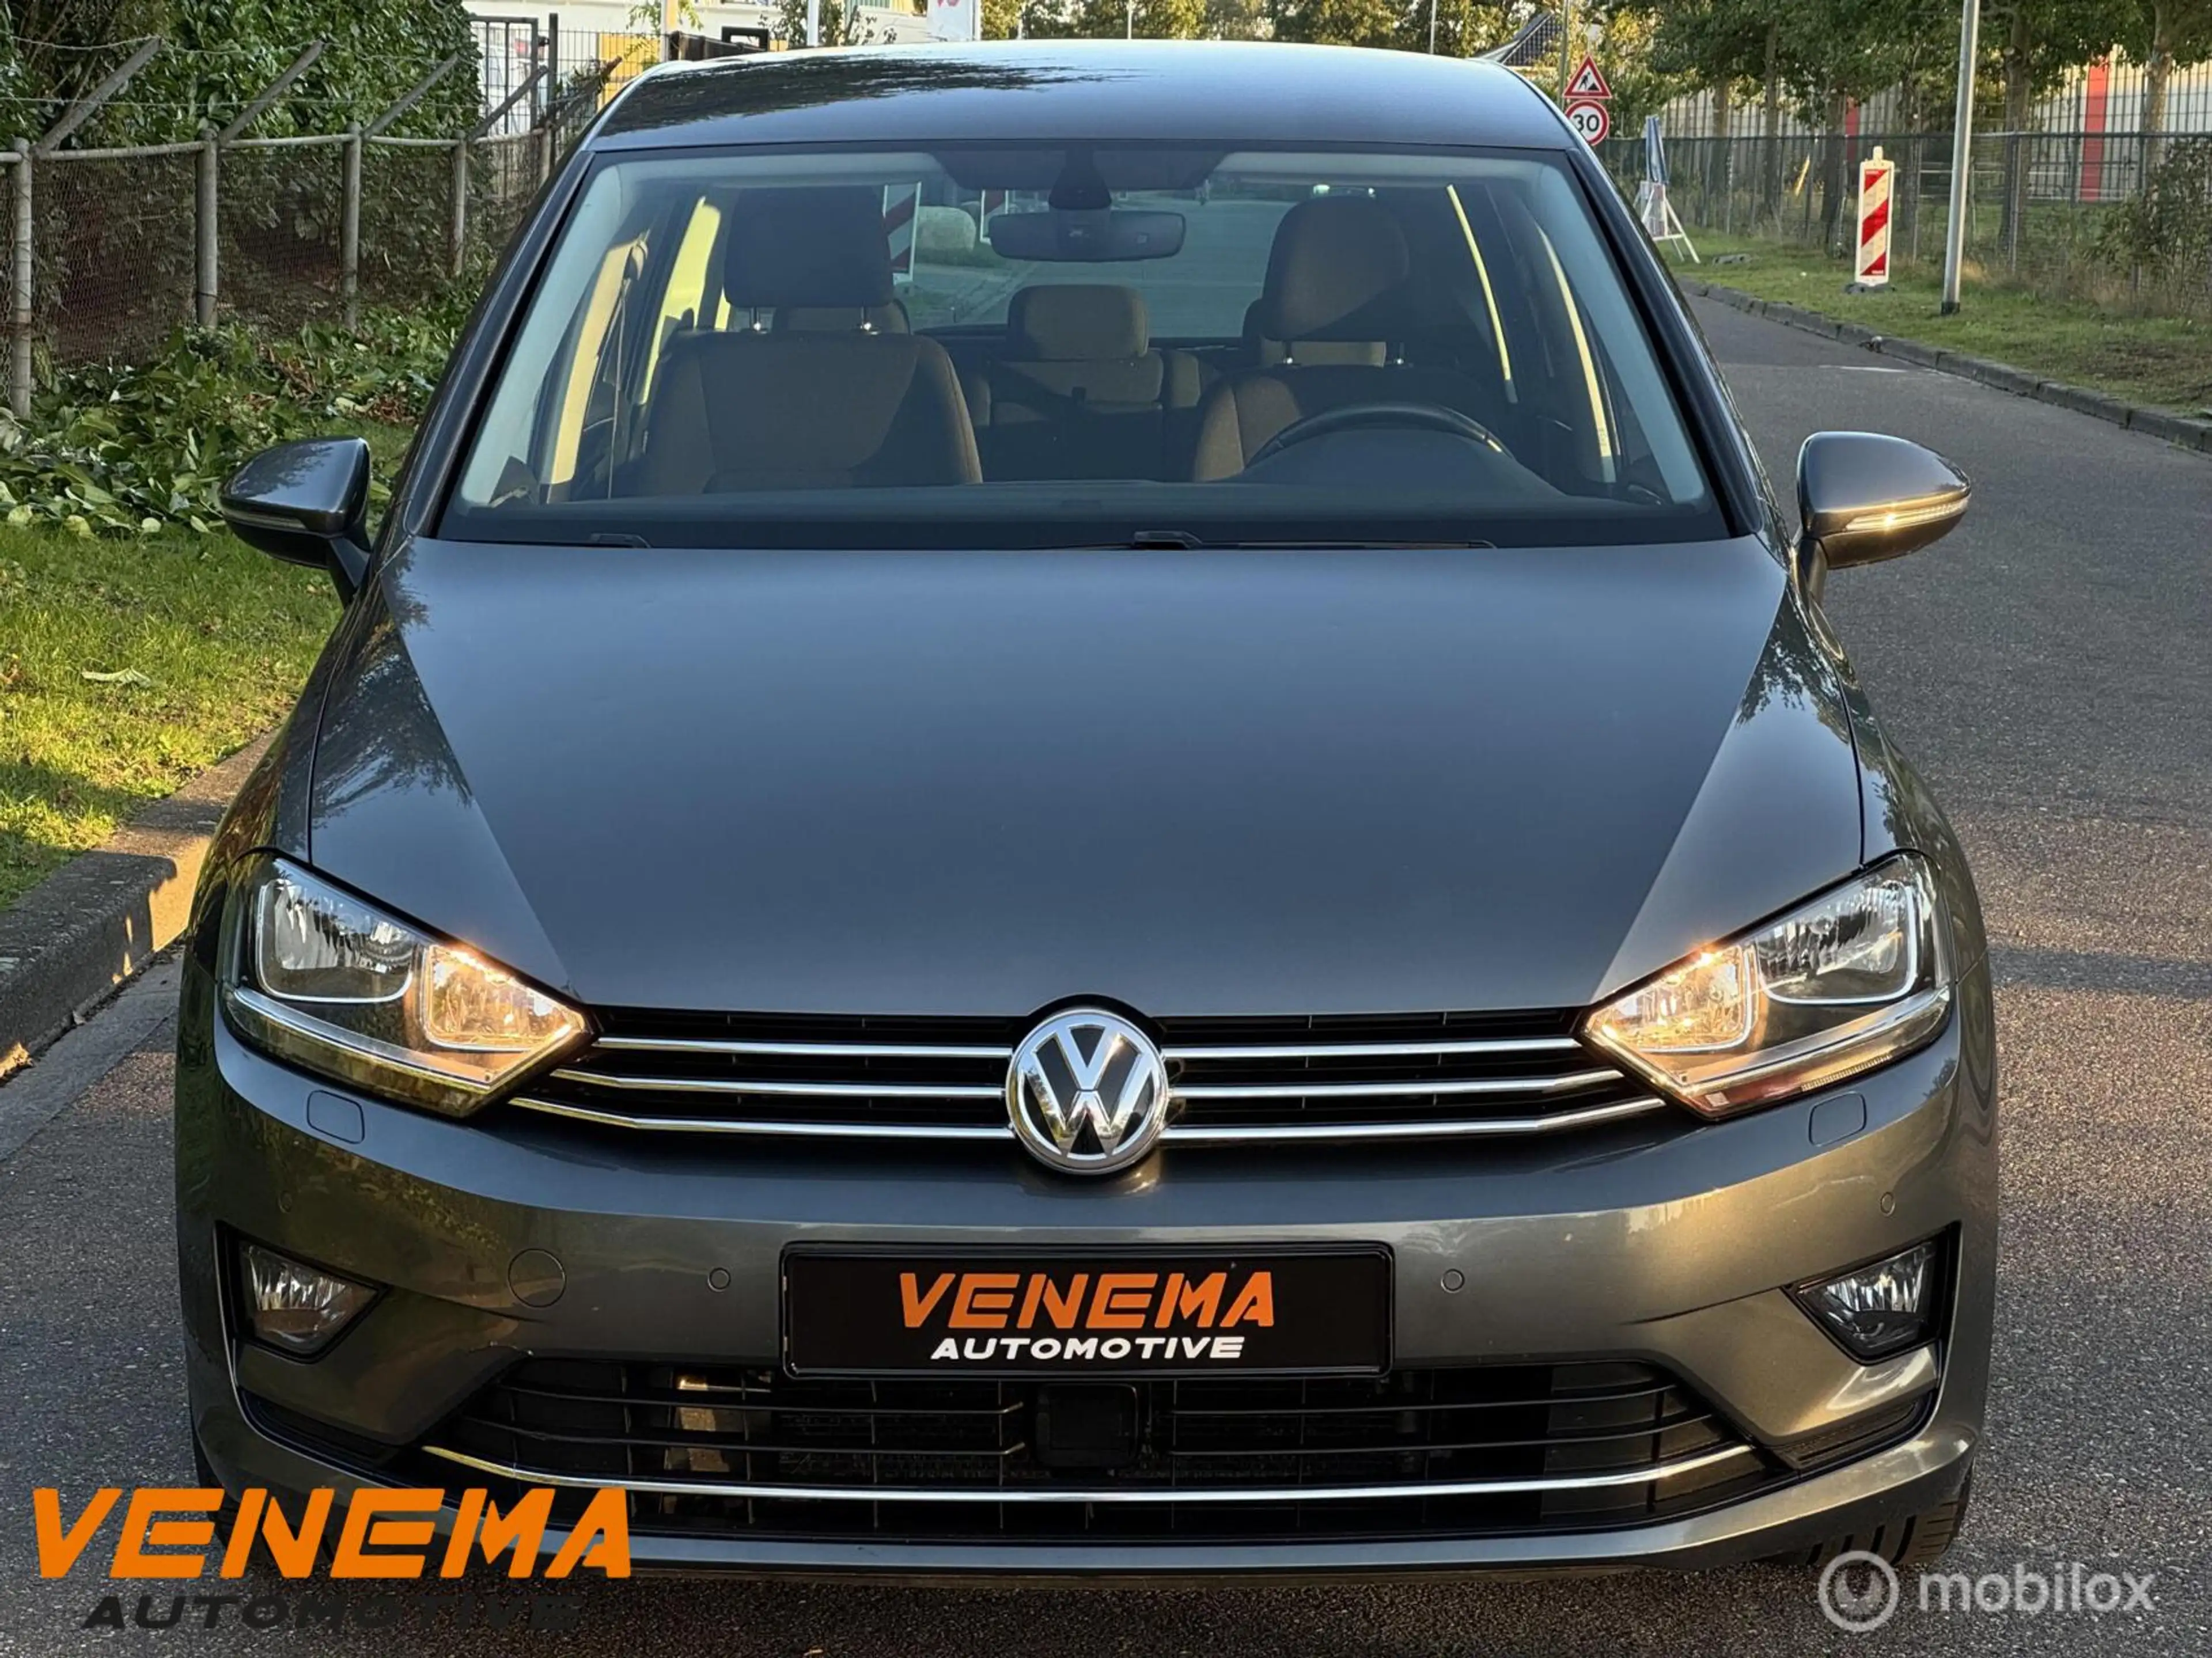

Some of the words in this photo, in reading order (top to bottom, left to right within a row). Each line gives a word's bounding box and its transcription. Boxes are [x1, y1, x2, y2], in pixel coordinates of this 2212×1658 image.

[1573, 114, 1600, 132] 30
[901, 1272, 1274, 1328] VENEMA
[931, 1337, 1245, 1360] AUTOMOTIVE
